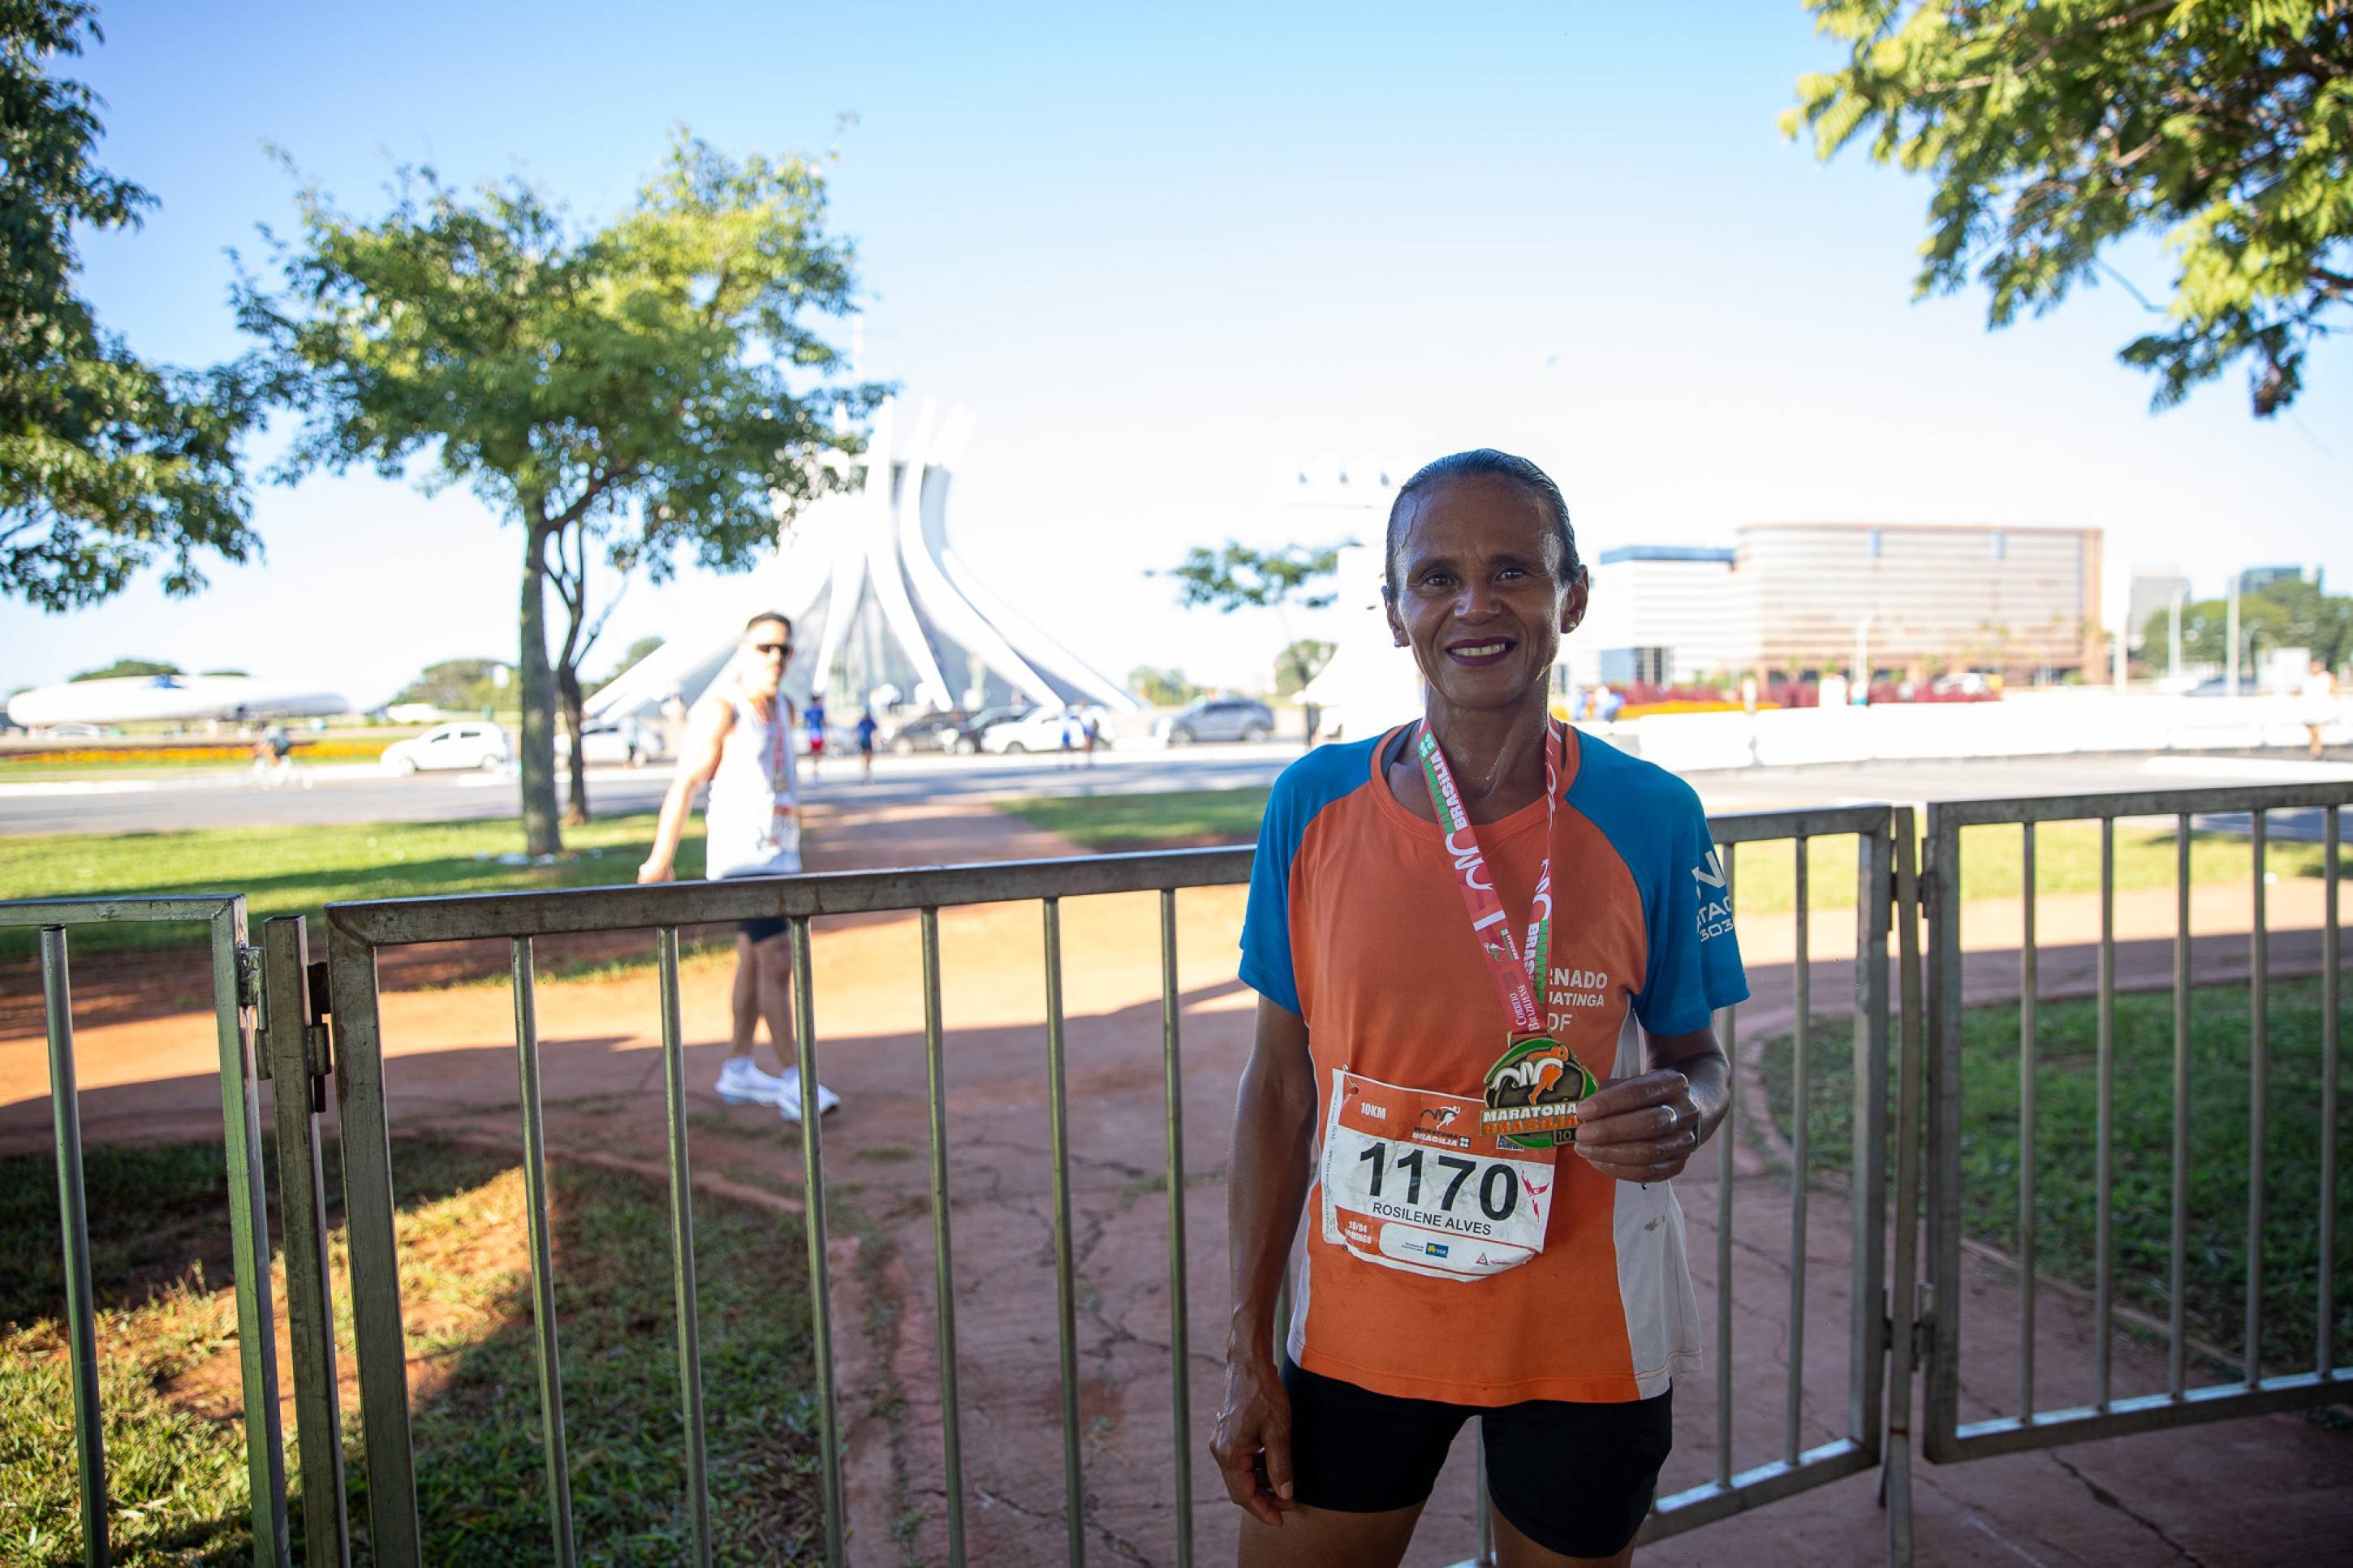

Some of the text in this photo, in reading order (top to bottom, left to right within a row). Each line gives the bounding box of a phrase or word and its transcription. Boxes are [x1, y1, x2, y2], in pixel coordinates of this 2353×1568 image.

[1424, 758, 1455, 835] MARATONA
[1523, 922, 1540, 987] BRAS
[1535, 920, 1549, 1013] MARATON
[1547, 1012, 1572, 1032] DF
[1361, 1101, 1387, 1120] 10KM
[1483, 1103, 1578, 1123] MARATONA
[1360, 1141, 1519, 1221] 1170
[1373, 1202, 1492, 1235] ROSILENE ALVES
